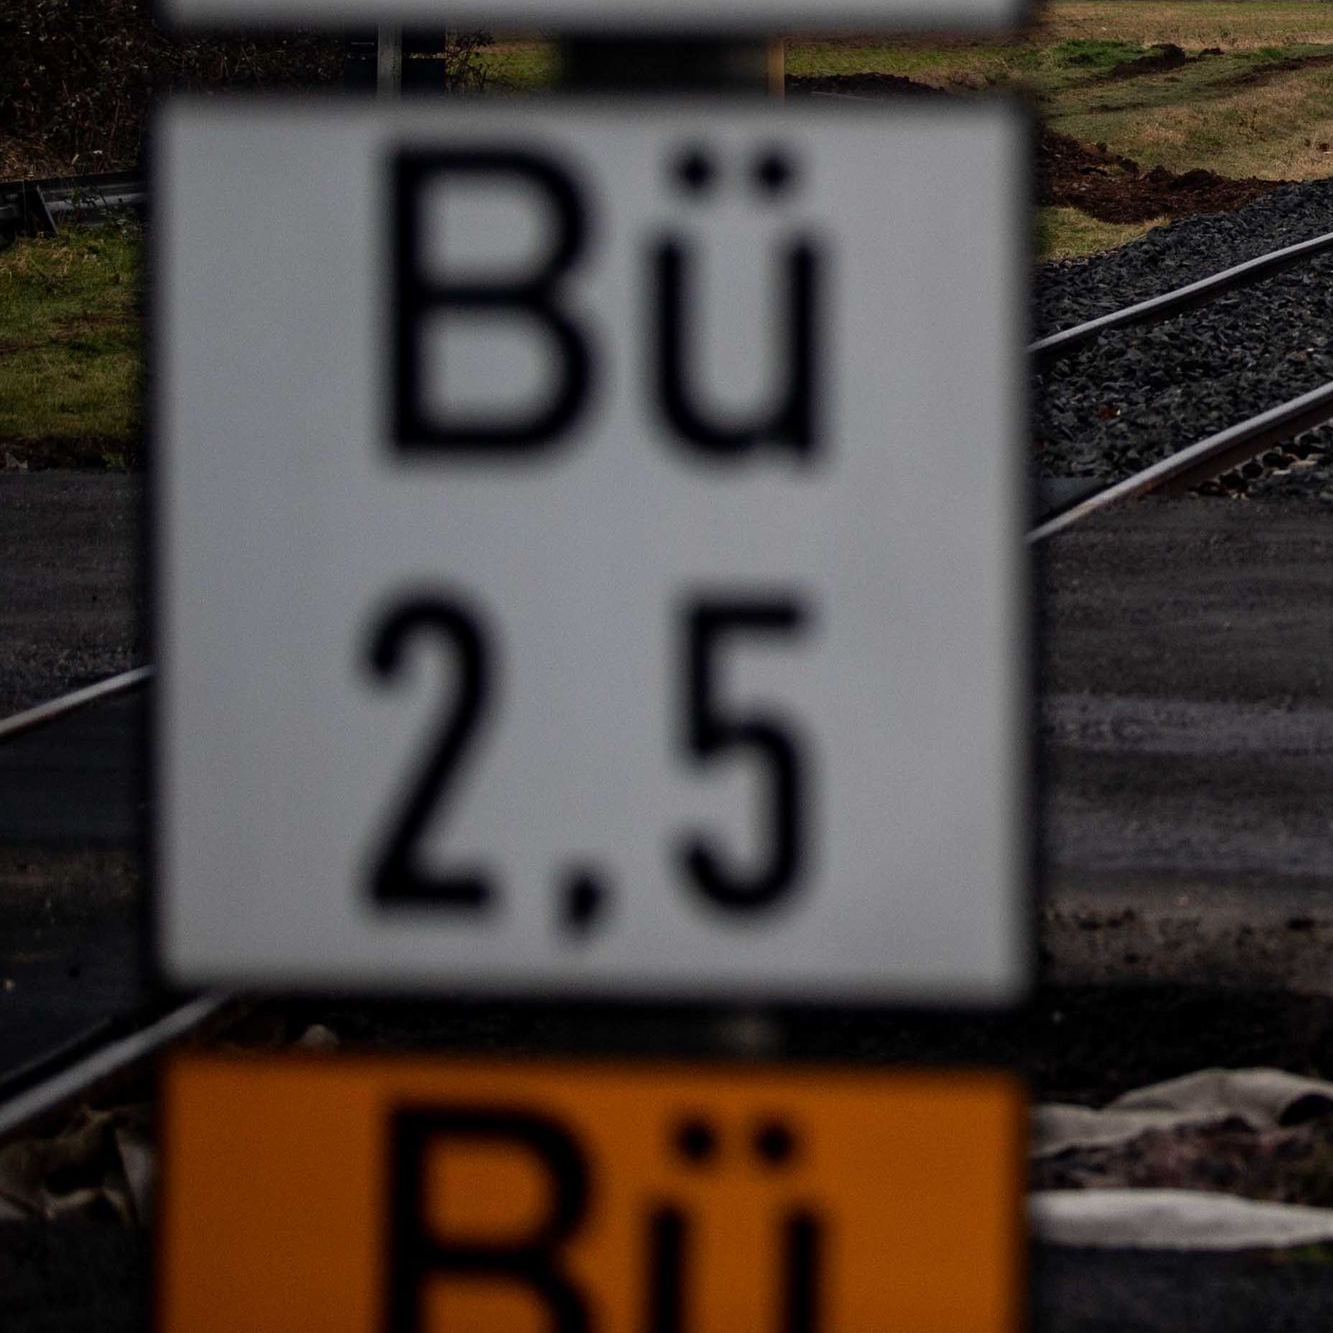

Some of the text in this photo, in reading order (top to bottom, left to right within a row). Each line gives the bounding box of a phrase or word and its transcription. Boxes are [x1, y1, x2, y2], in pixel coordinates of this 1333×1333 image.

[377, 134, 830, 467] Bü
[357, 584, 818, 942] 2,5
[375, 1095, 830, 1333] Bü
